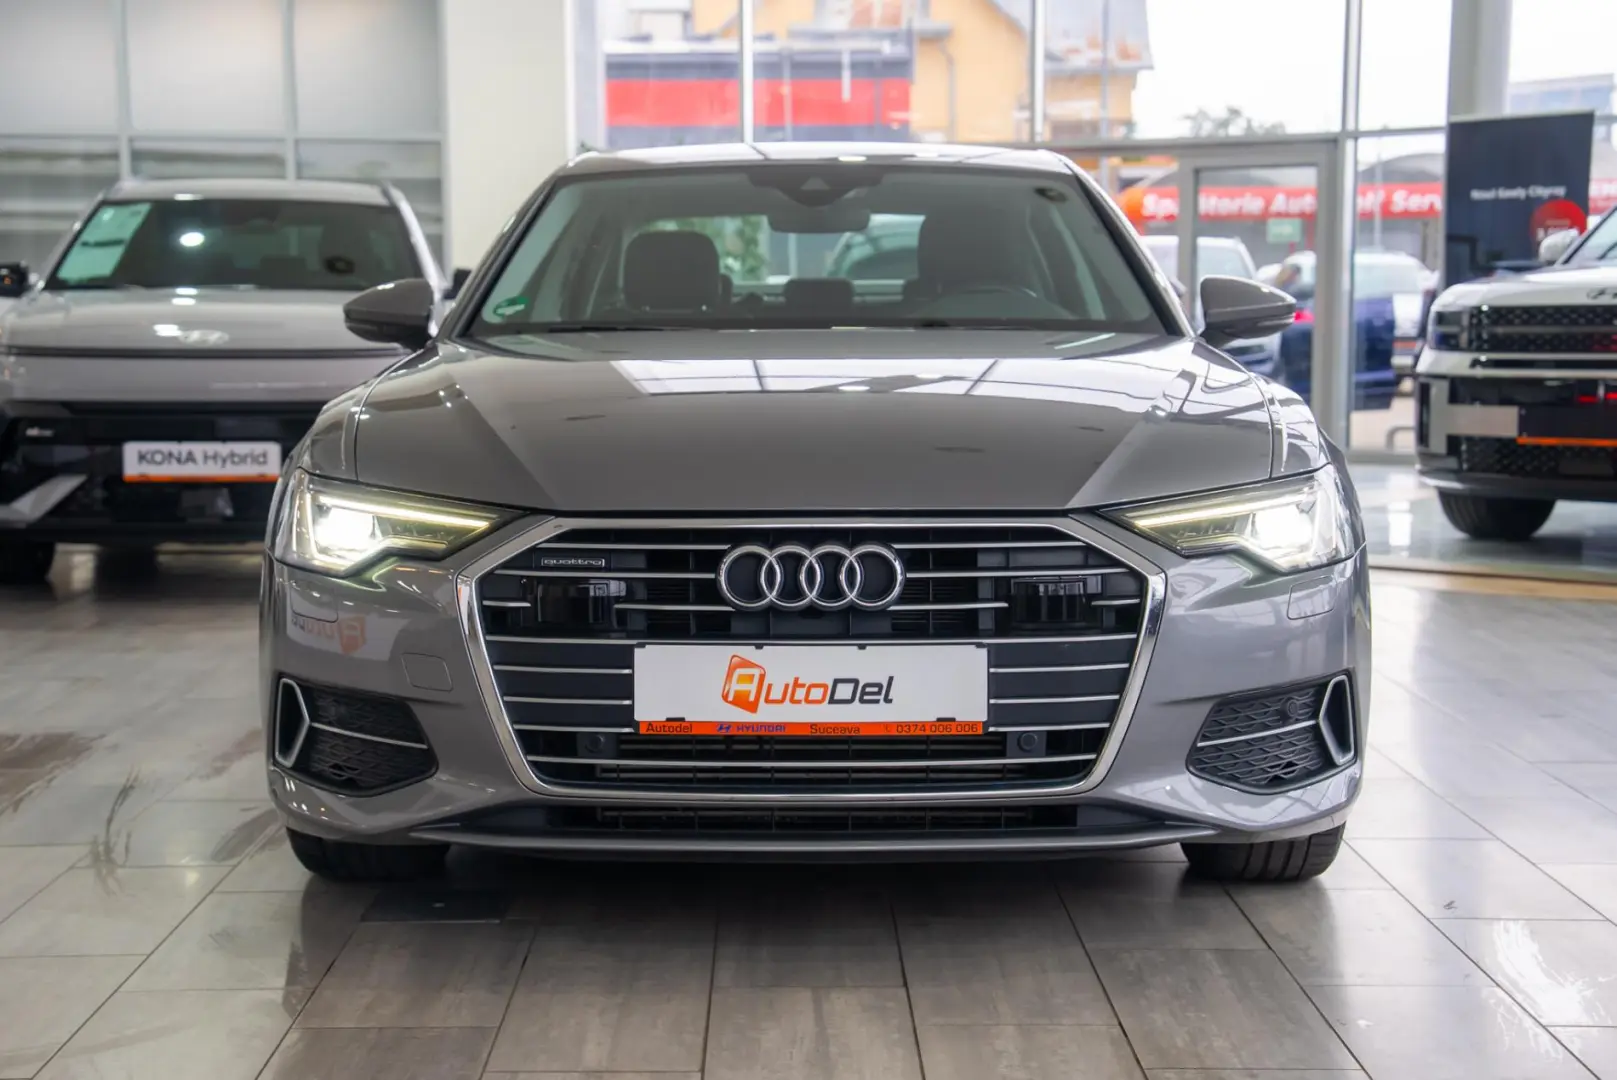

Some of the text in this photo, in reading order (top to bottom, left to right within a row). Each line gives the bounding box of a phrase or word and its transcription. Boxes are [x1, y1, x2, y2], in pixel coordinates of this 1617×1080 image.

[137, 449, 268, 468] KONA Hybrid
[543, 558, 602, 567] quattro
[728, 664, 894, 706] AutoDel
[645, 722, 978, 734] Autodel HYUNDAI Suceava 0374 006 006
